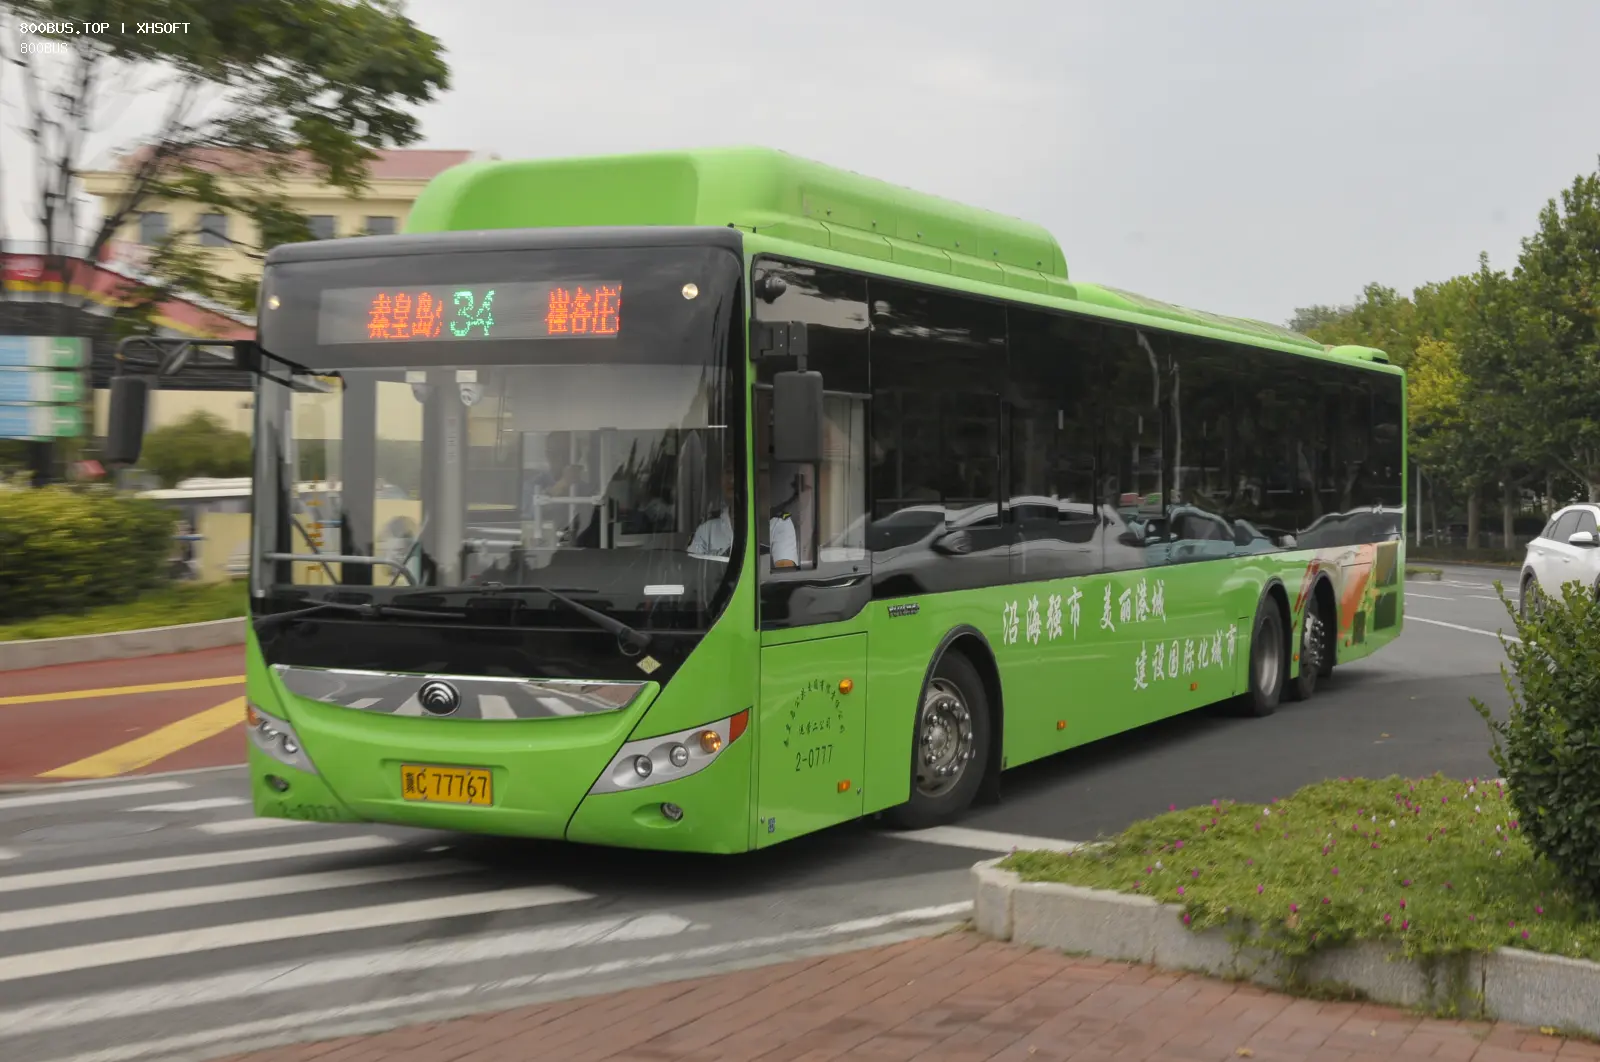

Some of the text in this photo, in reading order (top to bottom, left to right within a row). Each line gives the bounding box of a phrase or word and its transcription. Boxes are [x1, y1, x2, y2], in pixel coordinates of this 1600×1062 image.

[450, 289, 494, 337] 34
[545, 284, 622, 334] 崔各庄
[1101, 577, 1167, 632] 美丽港城
[1133, 623, 1237, 691] 建设国际化城市
[795, 744, 834, 772] 2-0777
